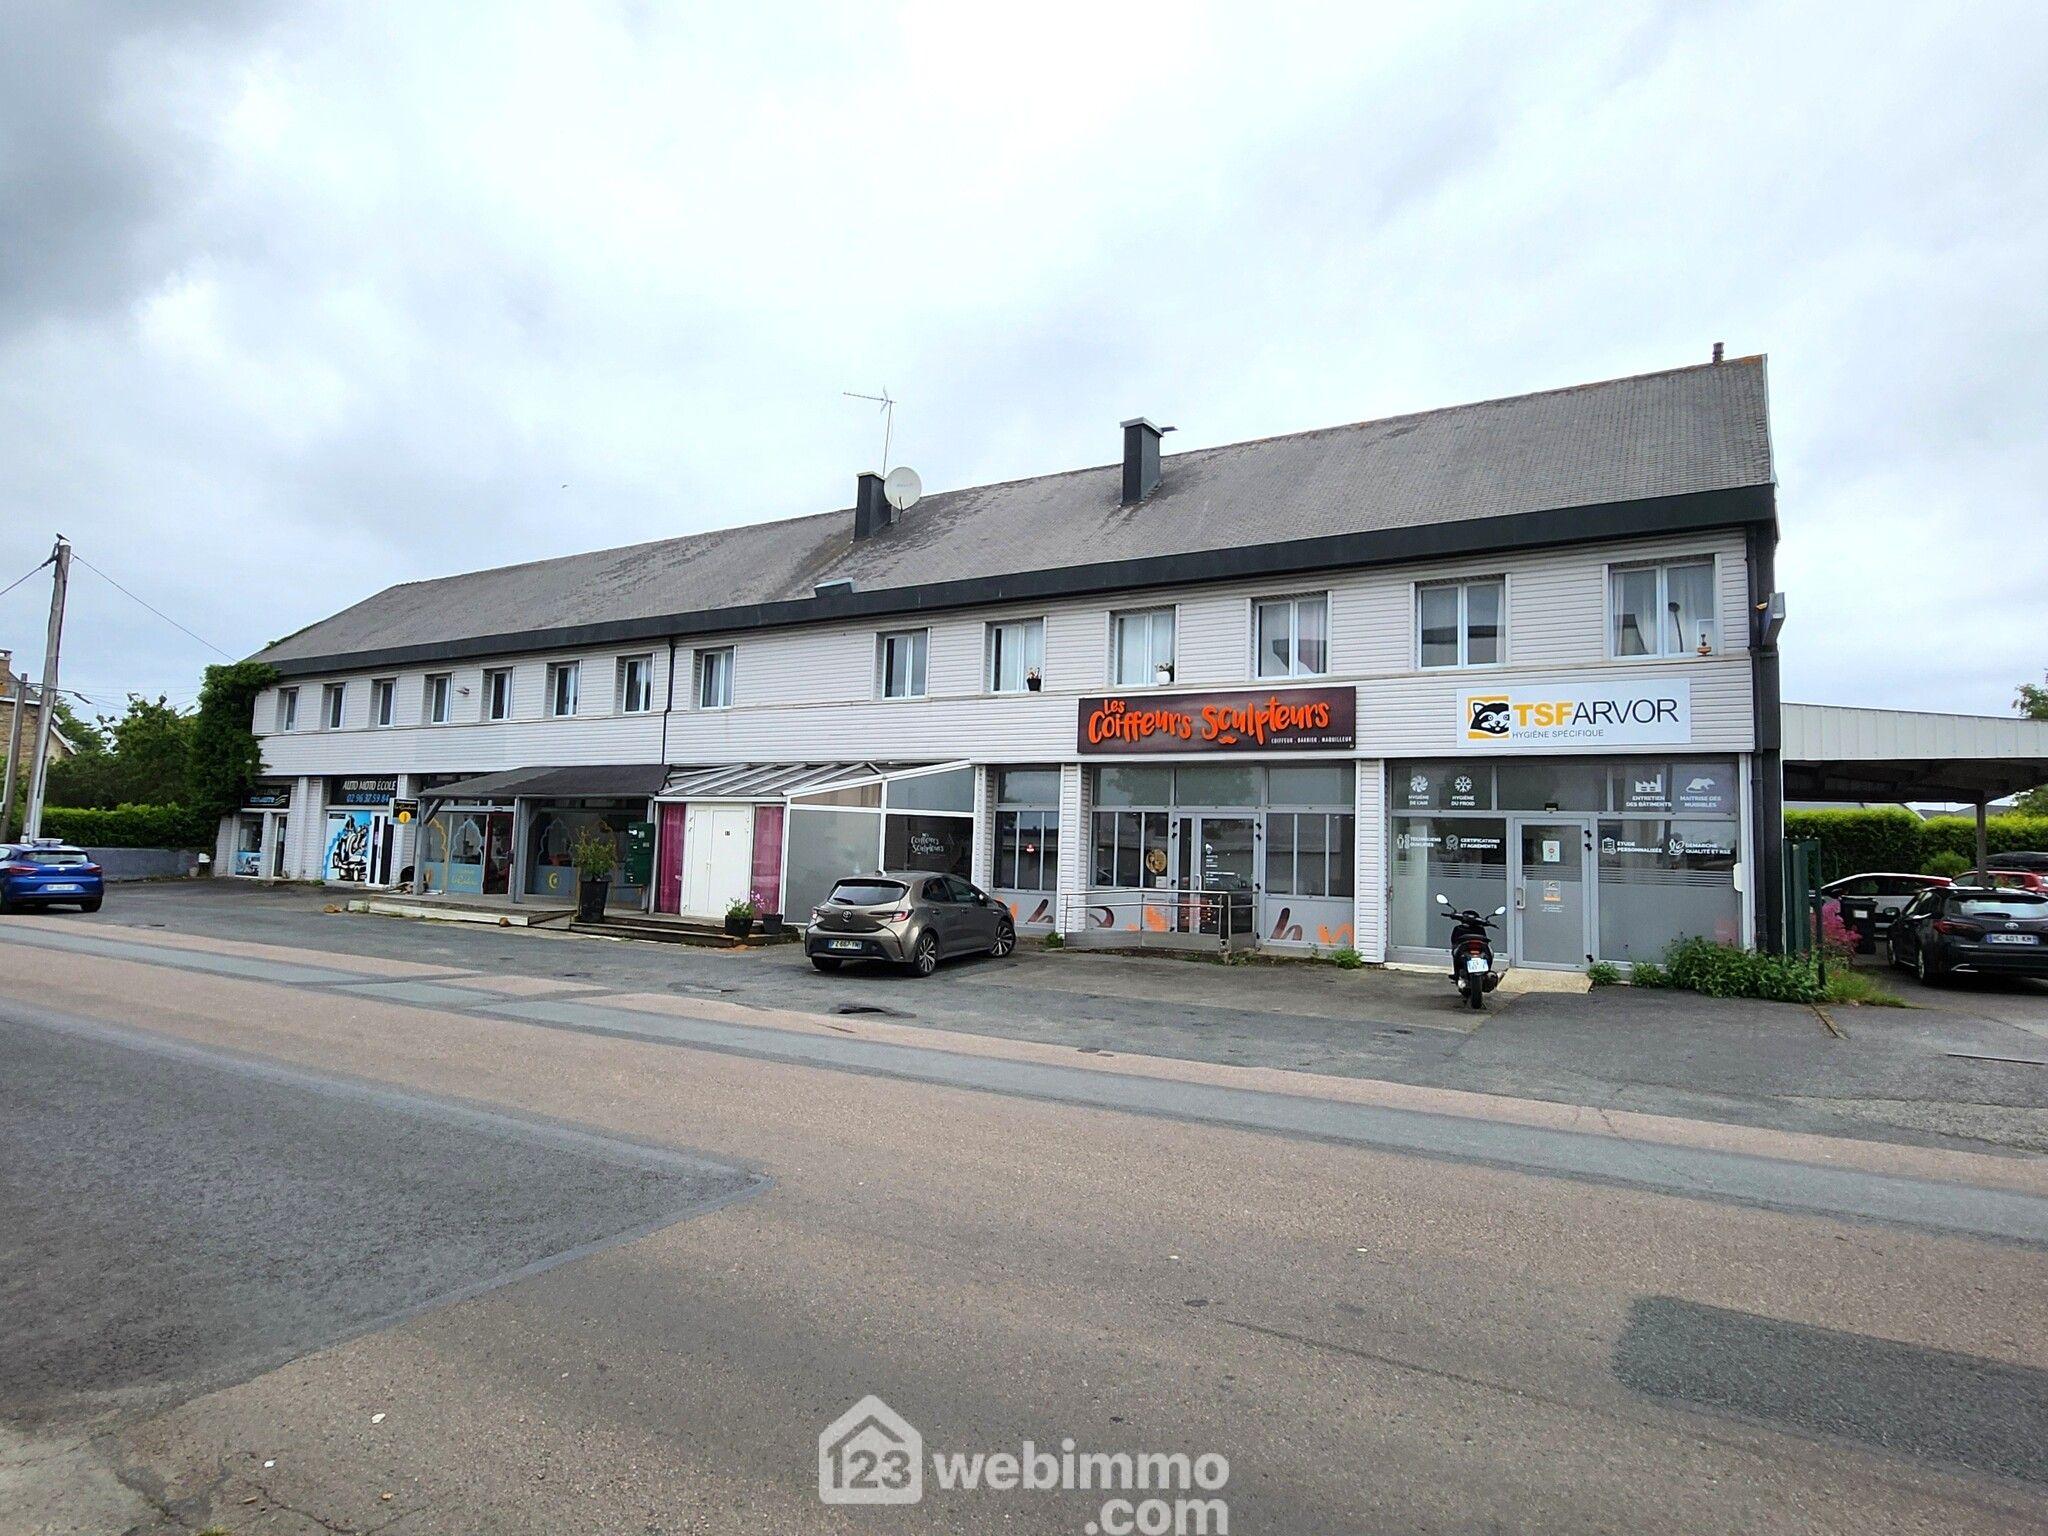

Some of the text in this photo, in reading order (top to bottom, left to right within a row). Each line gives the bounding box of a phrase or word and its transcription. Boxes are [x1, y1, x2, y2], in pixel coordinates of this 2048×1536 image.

[1103, 698, 1126, 713] Les
[1088, 695, 1330, 745] Coiffeurs Sculpteurs
[1552, 729, 1604, 738] SPÉCIFIQUE
[342, 780, 358, 790] AUTO
[359, 780, 376, 790] MOTO
